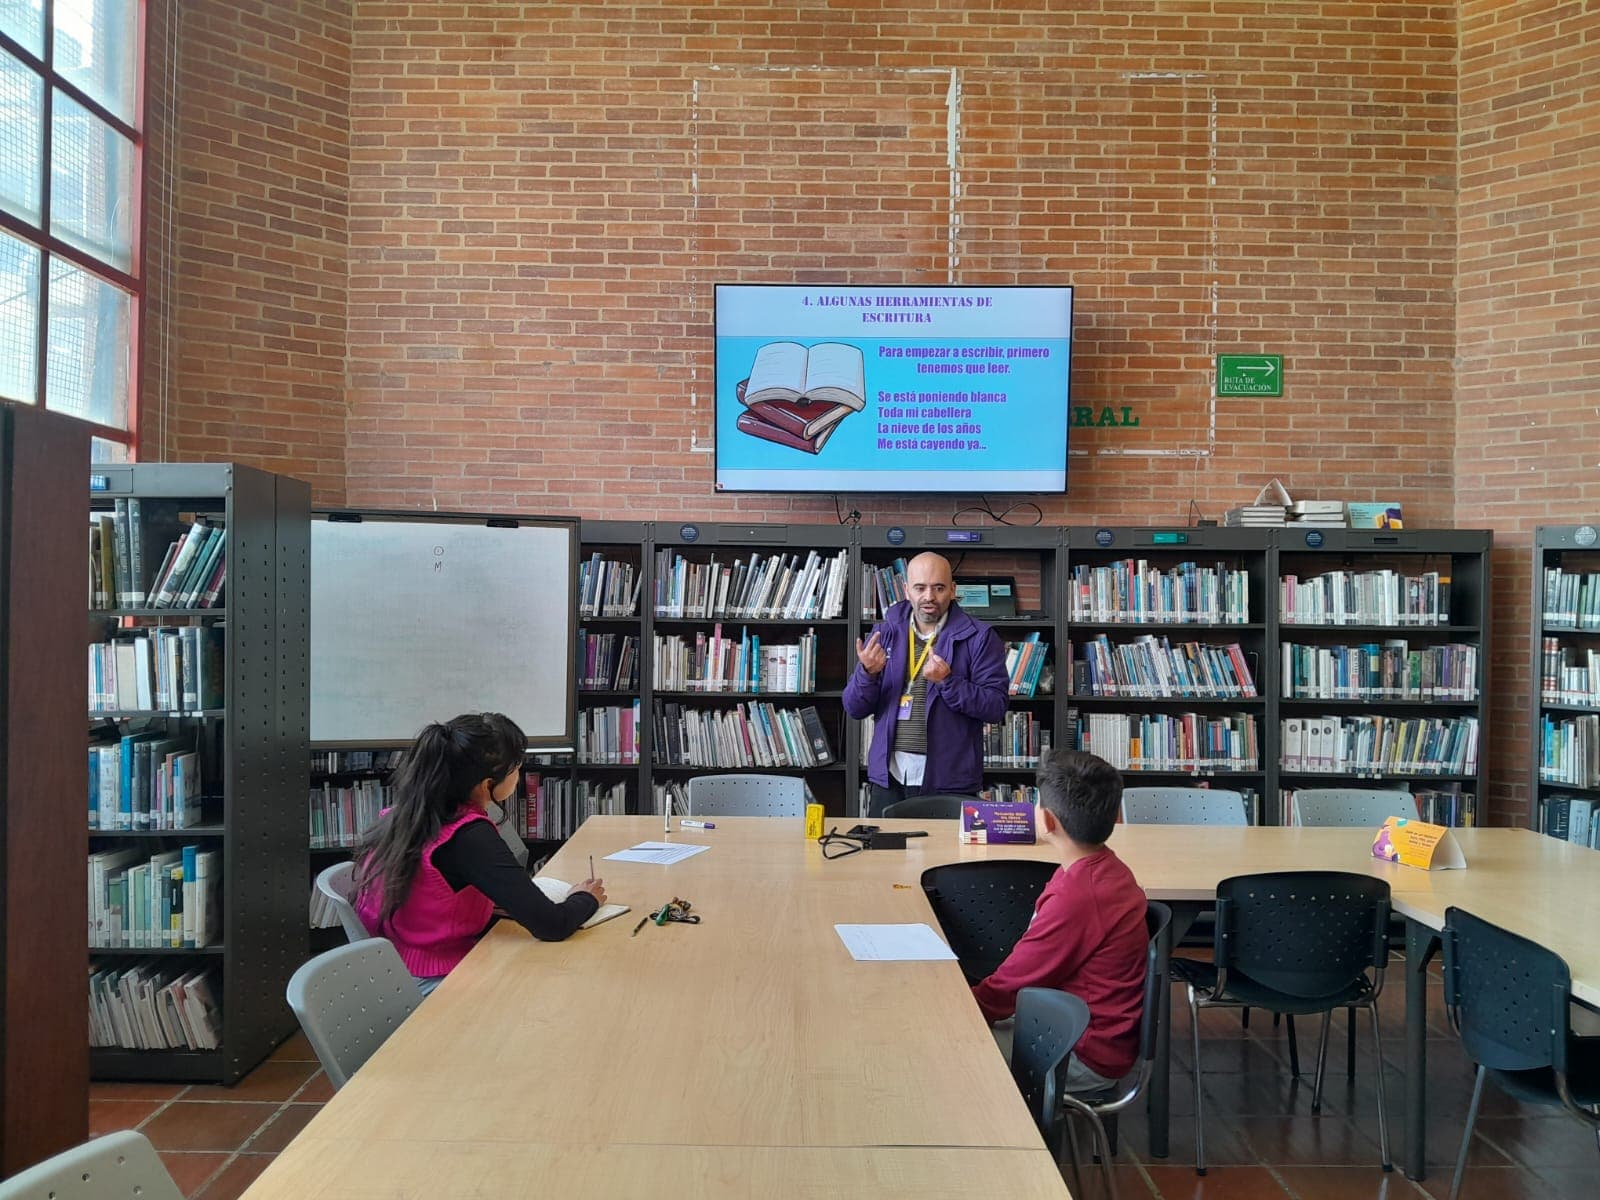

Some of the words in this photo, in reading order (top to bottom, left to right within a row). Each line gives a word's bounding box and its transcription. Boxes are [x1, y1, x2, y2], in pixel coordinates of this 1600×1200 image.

[801, 296, 813, 307] 4.
[816, 295, 872, 307] ALGUNAS
[876, 296, 973, 308] HERRAMIENTAS
[976, 296, 993, 308] DE
[862, 312, 932, 323] ESCRITURA
[879, 346, 903, 358] Para
[905, 347, 951, 359] empezar
[952, 347, 960, 358] a
[961, 346, 1005, 359] escribir,
[1006, 346, 1050, 359] primero
[917, 362, 963, 374] tenemos
[965, 363, 986, 375] que
[987, 362, 1011, 374] leer.
[1224, 376, 1244, 384] RUTA
[1245, 376, 1255, 384] DE
[878, 391, 892, 403] Se
[893, 390, 916, 403] está
[918, 391, 969, 404] poniendo
[970, 391, 1007, 403] blanca
[878, 406, 903, 418] Toda
[905, 406, 919, 418] mi
[921, 406, 972, 418] cabellera
[1070, 405, 1140, 427] RAL
[877, 422, 889, 434] La
[891, 422, 920, 434] nieve
[922, 422, 936, 434] de
[937, 422, 954, 434] los
[955, 422, 982, 434] años
[877, 438, 893, 450] Me
[895, 437, 918, 450] está
[920, 438, 965, 451] cayendo
